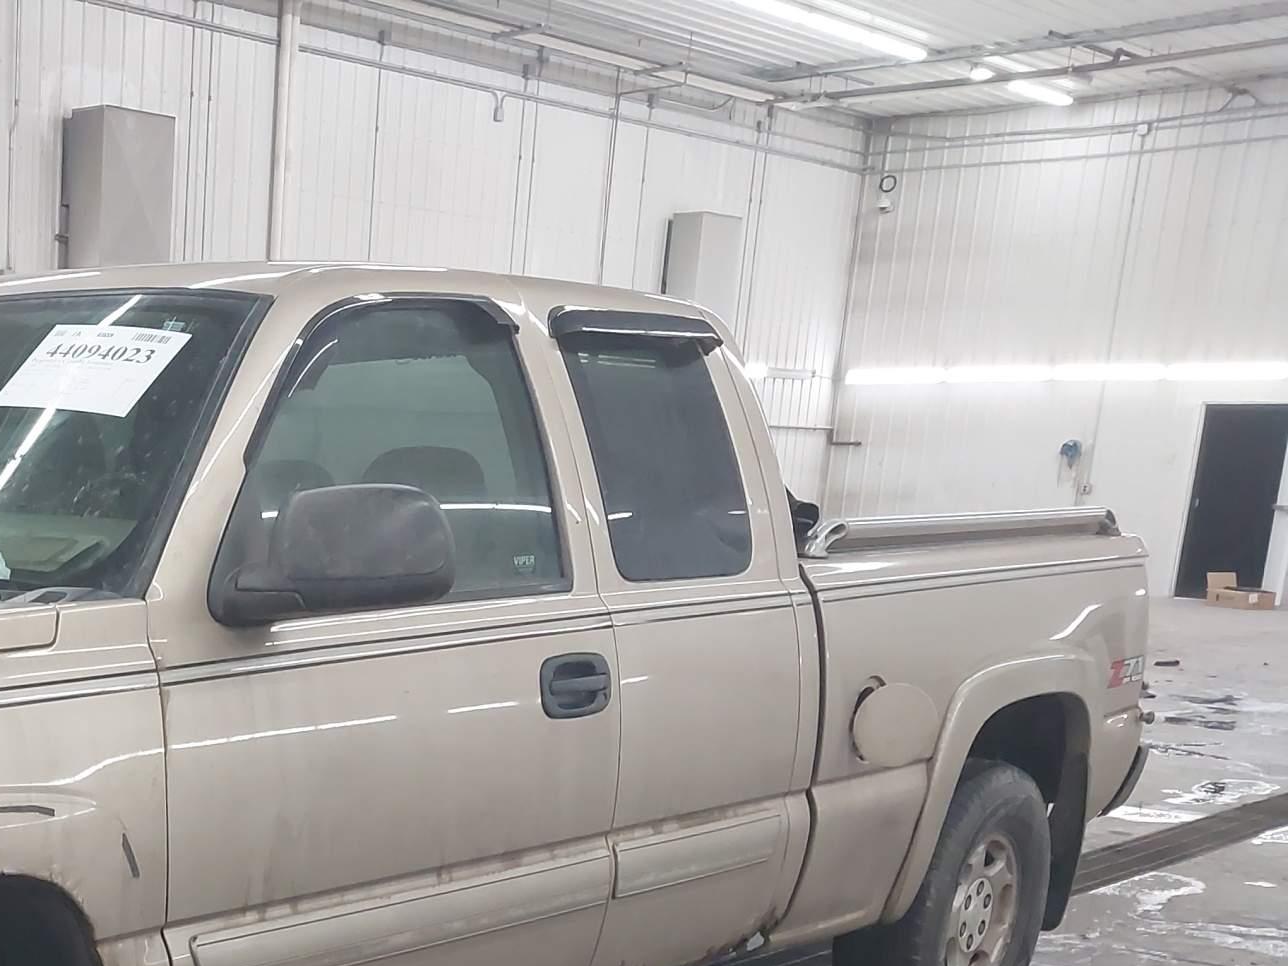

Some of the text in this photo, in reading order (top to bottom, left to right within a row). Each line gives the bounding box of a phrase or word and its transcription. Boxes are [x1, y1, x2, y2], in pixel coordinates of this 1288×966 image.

[46, 343, 156, 363] 44094023
[513, 555, 535, 566] VIPER
[1107, 655, 1145, 689] Z71
